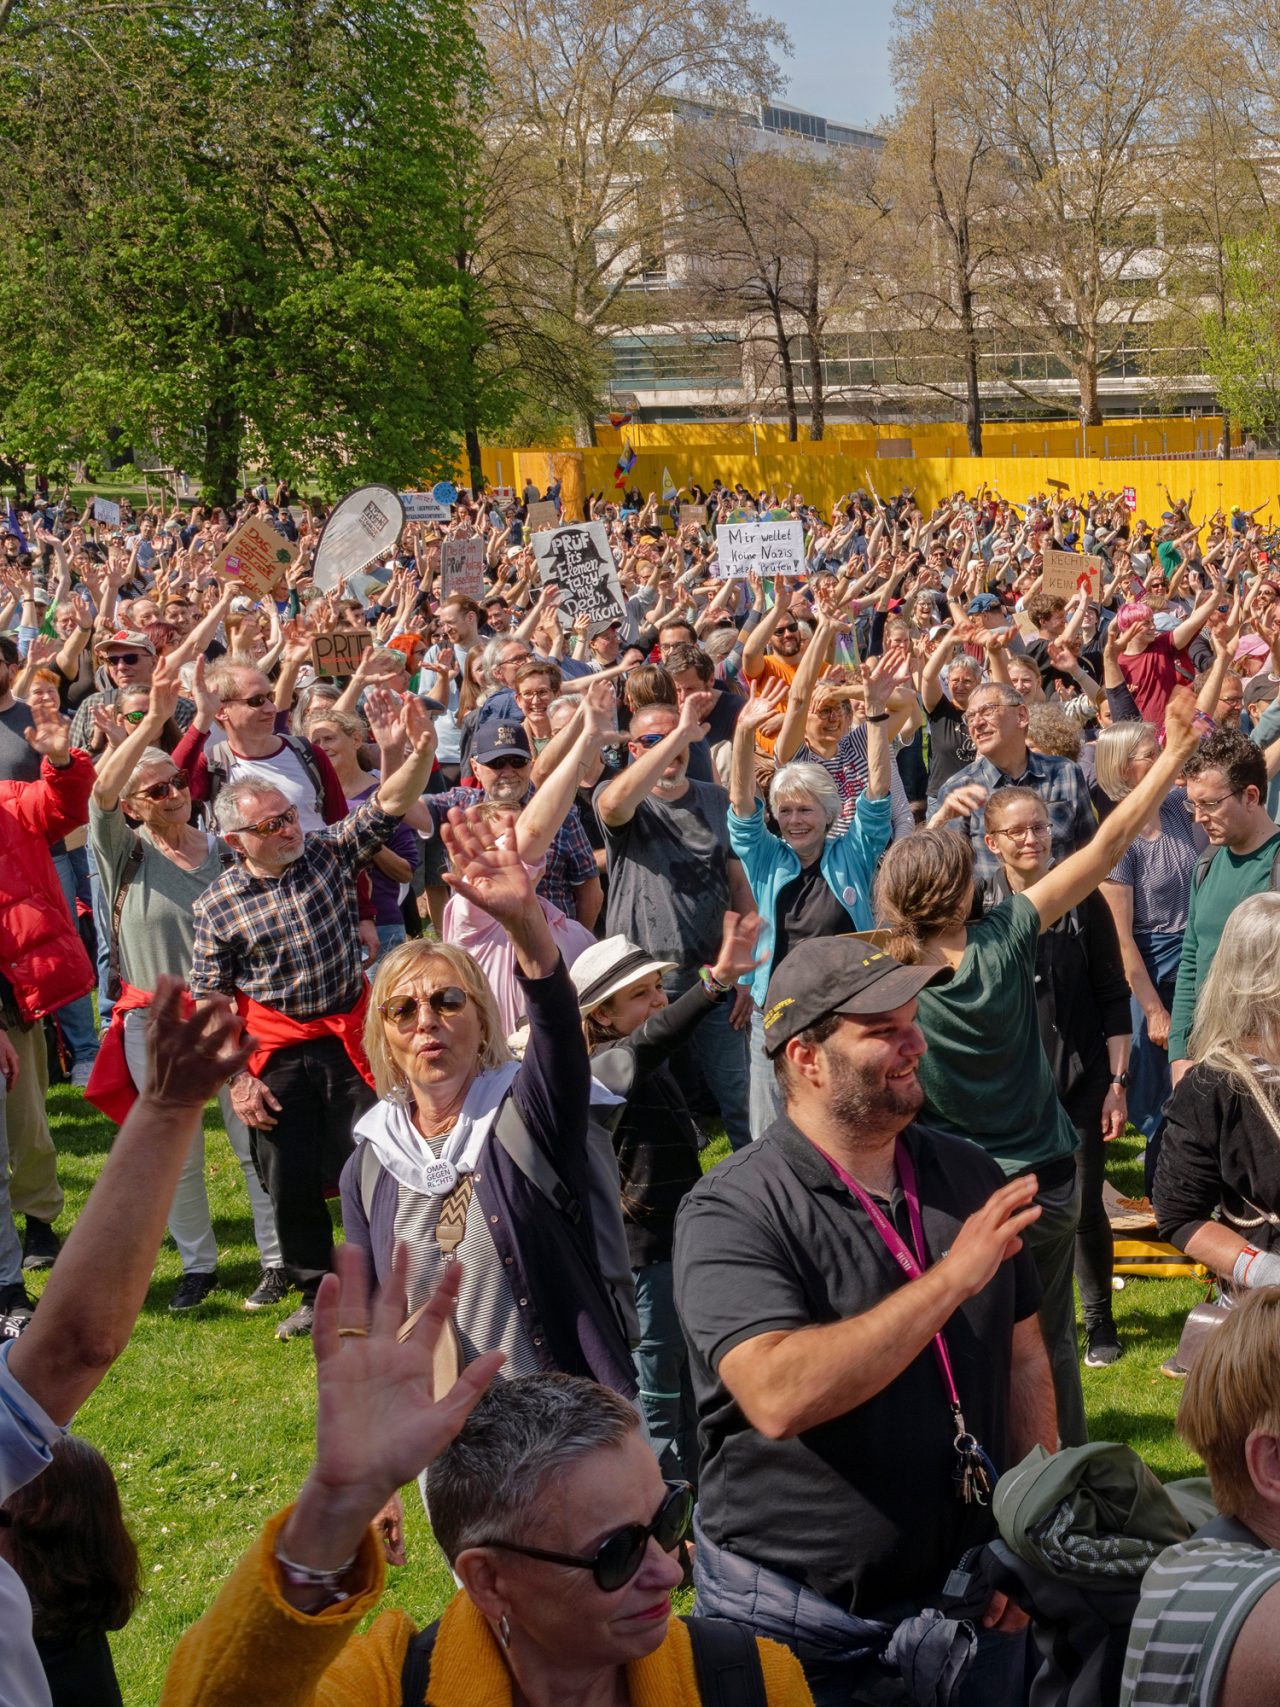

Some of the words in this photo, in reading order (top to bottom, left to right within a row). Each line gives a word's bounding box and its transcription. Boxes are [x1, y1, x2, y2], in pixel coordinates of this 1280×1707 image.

[247, 527, 272, 554] Das
[552, 532, 590, 555] PRÜF
[729, 529, 755, 544] Mir
[761, 529, 791, 541] wellet
[565, 551, 582, 565] It's
[761, 545, 792, 559] Nazis
[557, 559, 598, 581] Elemen
[566, 571, 604, 593] tary,
[577, 584, 594, 598] my
[564, 592, 607, 615] Dear
[426, 1162, 447, 1174] OMAS
[427, 1169, 450, 1181] GEGEN
[427, 1175, 453, 1188] RECHTS
